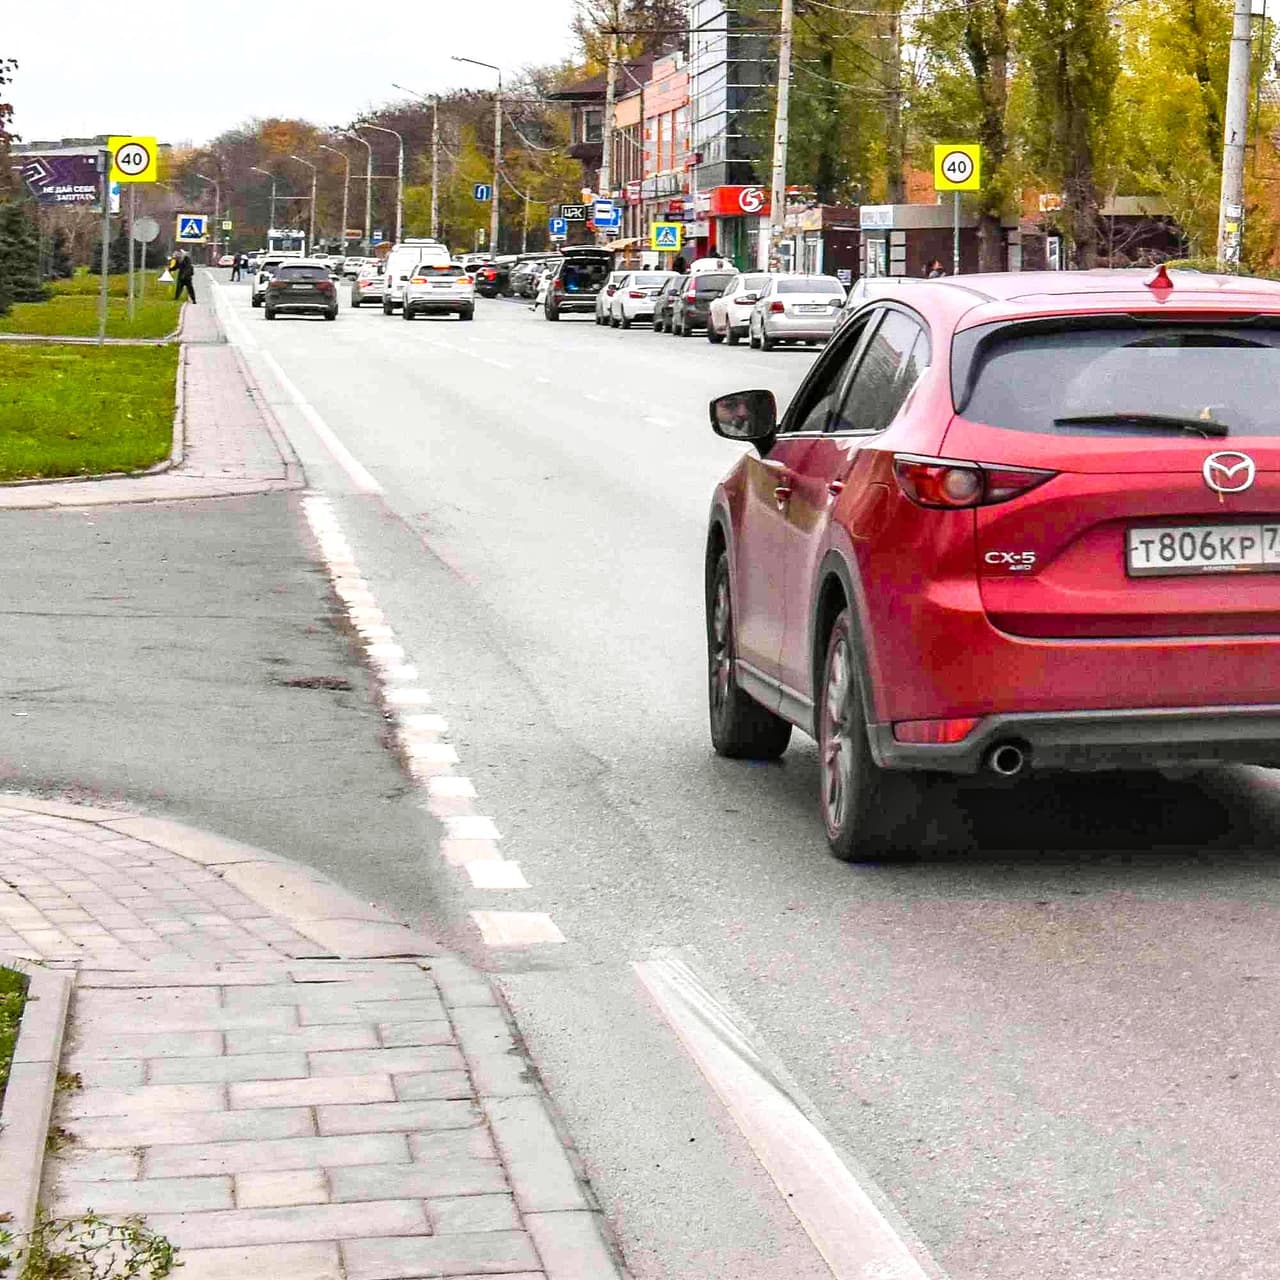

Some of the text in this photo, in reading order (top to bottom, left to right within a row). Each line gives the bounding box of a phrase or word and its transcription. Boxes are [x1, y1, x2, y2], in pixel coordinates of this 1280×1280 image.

[121, 152, 142, 166] 40
[946, 160, 967, 174] 40
[1139, 530, 1255, 563] Т806КР
[984, 551, 1036, 564] CX-5
